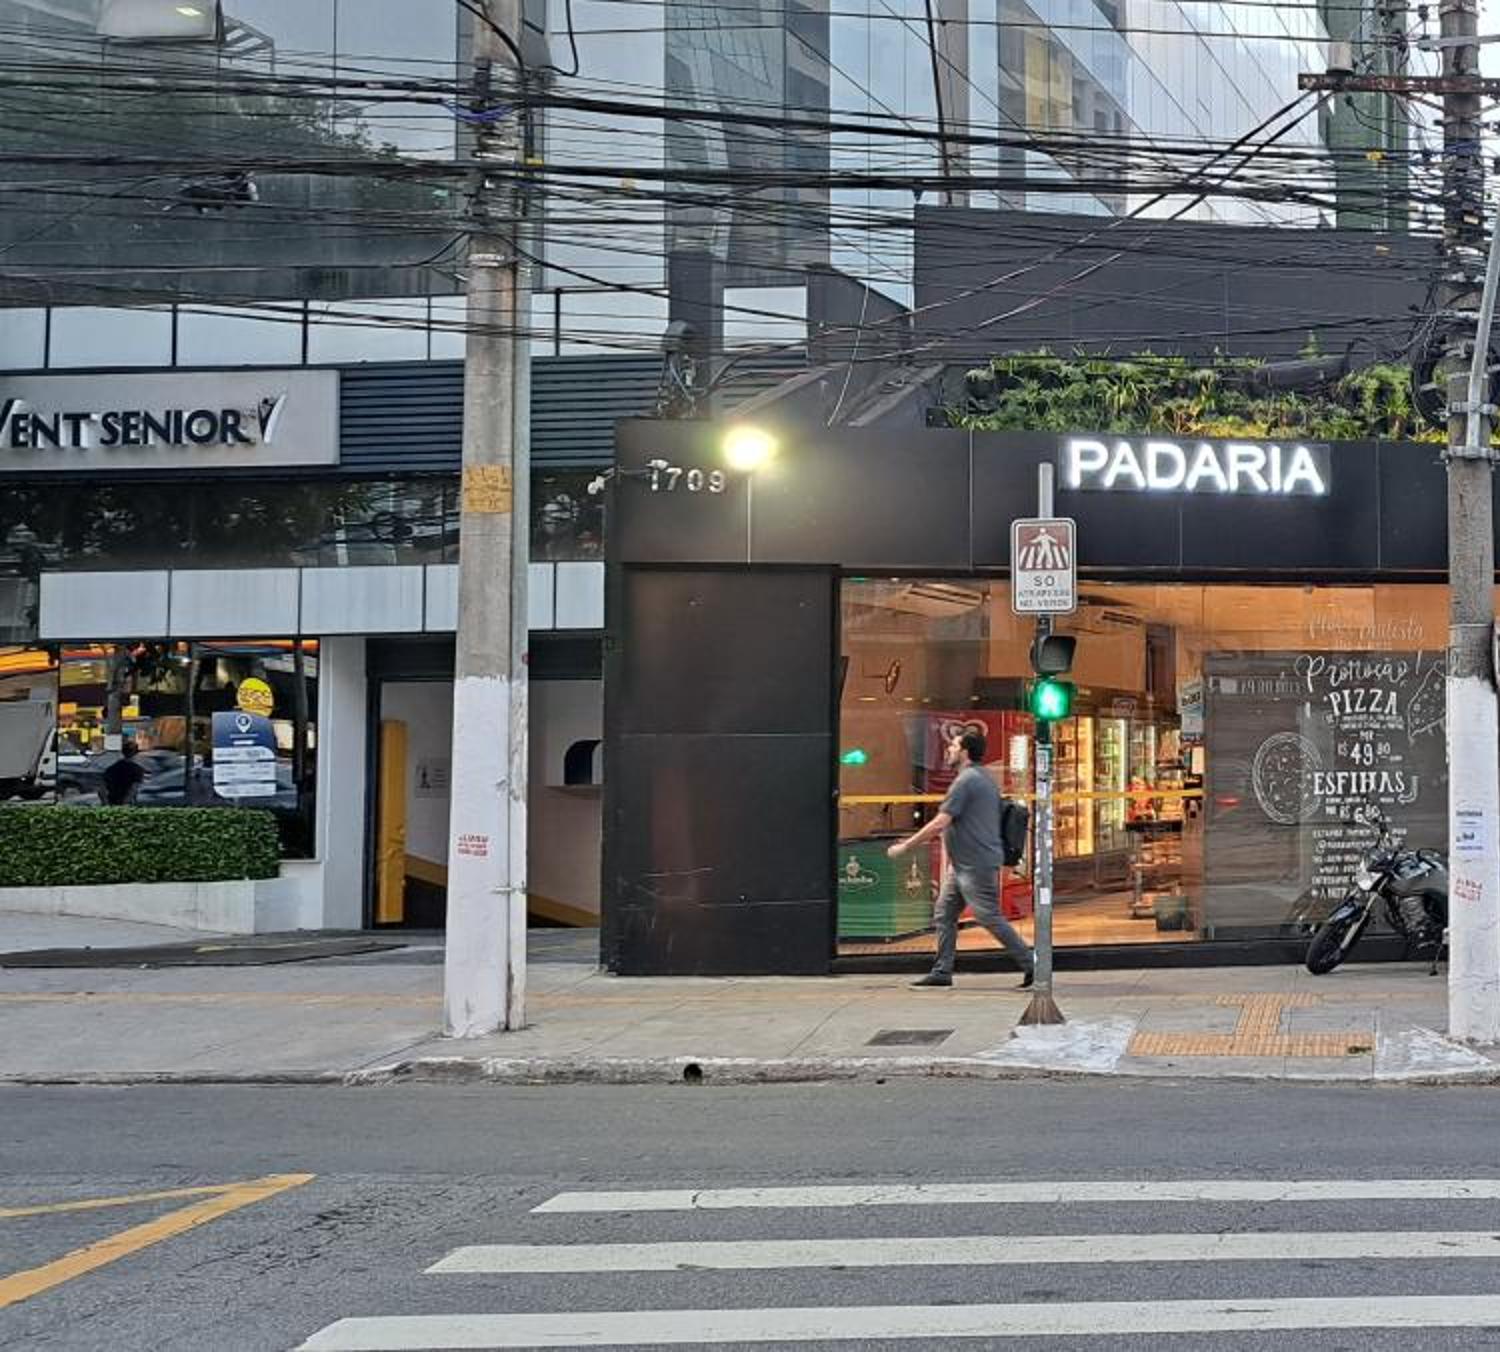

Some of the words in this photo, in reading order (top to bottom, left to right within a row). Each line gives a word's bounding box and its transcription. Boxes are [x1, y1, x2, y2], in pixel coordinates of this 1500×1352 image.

[100, 409, 251, 446] SENIOR
[651, 465, 725, 493] 1709
[1069, 440, 1325, 493] PADARIA
[1329, 688, 1397, 716] PIZZA
[1313, 771, 1405, 795] ESFIHAS
